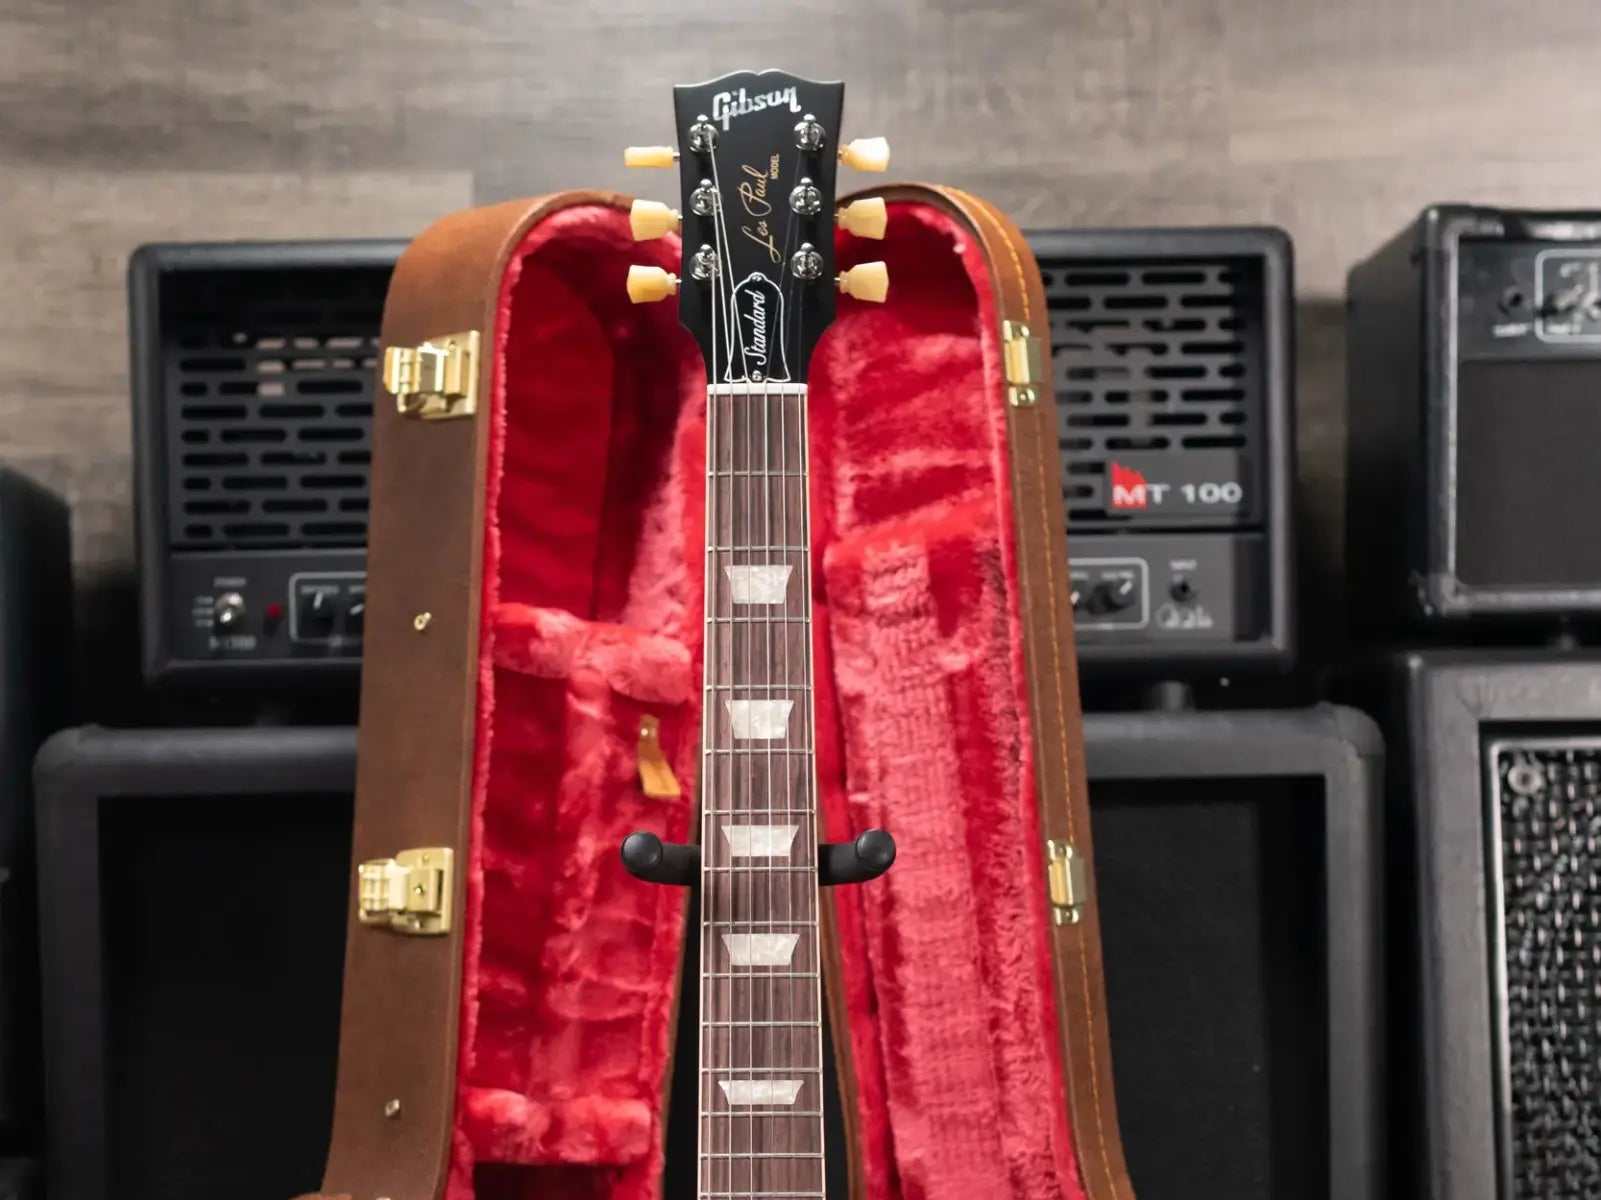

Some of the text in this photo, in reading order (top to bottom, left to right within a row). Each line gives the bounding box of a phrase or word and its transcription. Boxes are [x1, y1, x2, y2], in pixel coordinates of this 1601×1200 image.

[712, 86, 802, 131] Gibson
[770, 153, 780, 180] MODEL
[737, 164, 781, 263] Les Paul
[743, 288, 768, 366] Standard
[1112, 482, 1243, 506] MT 100
